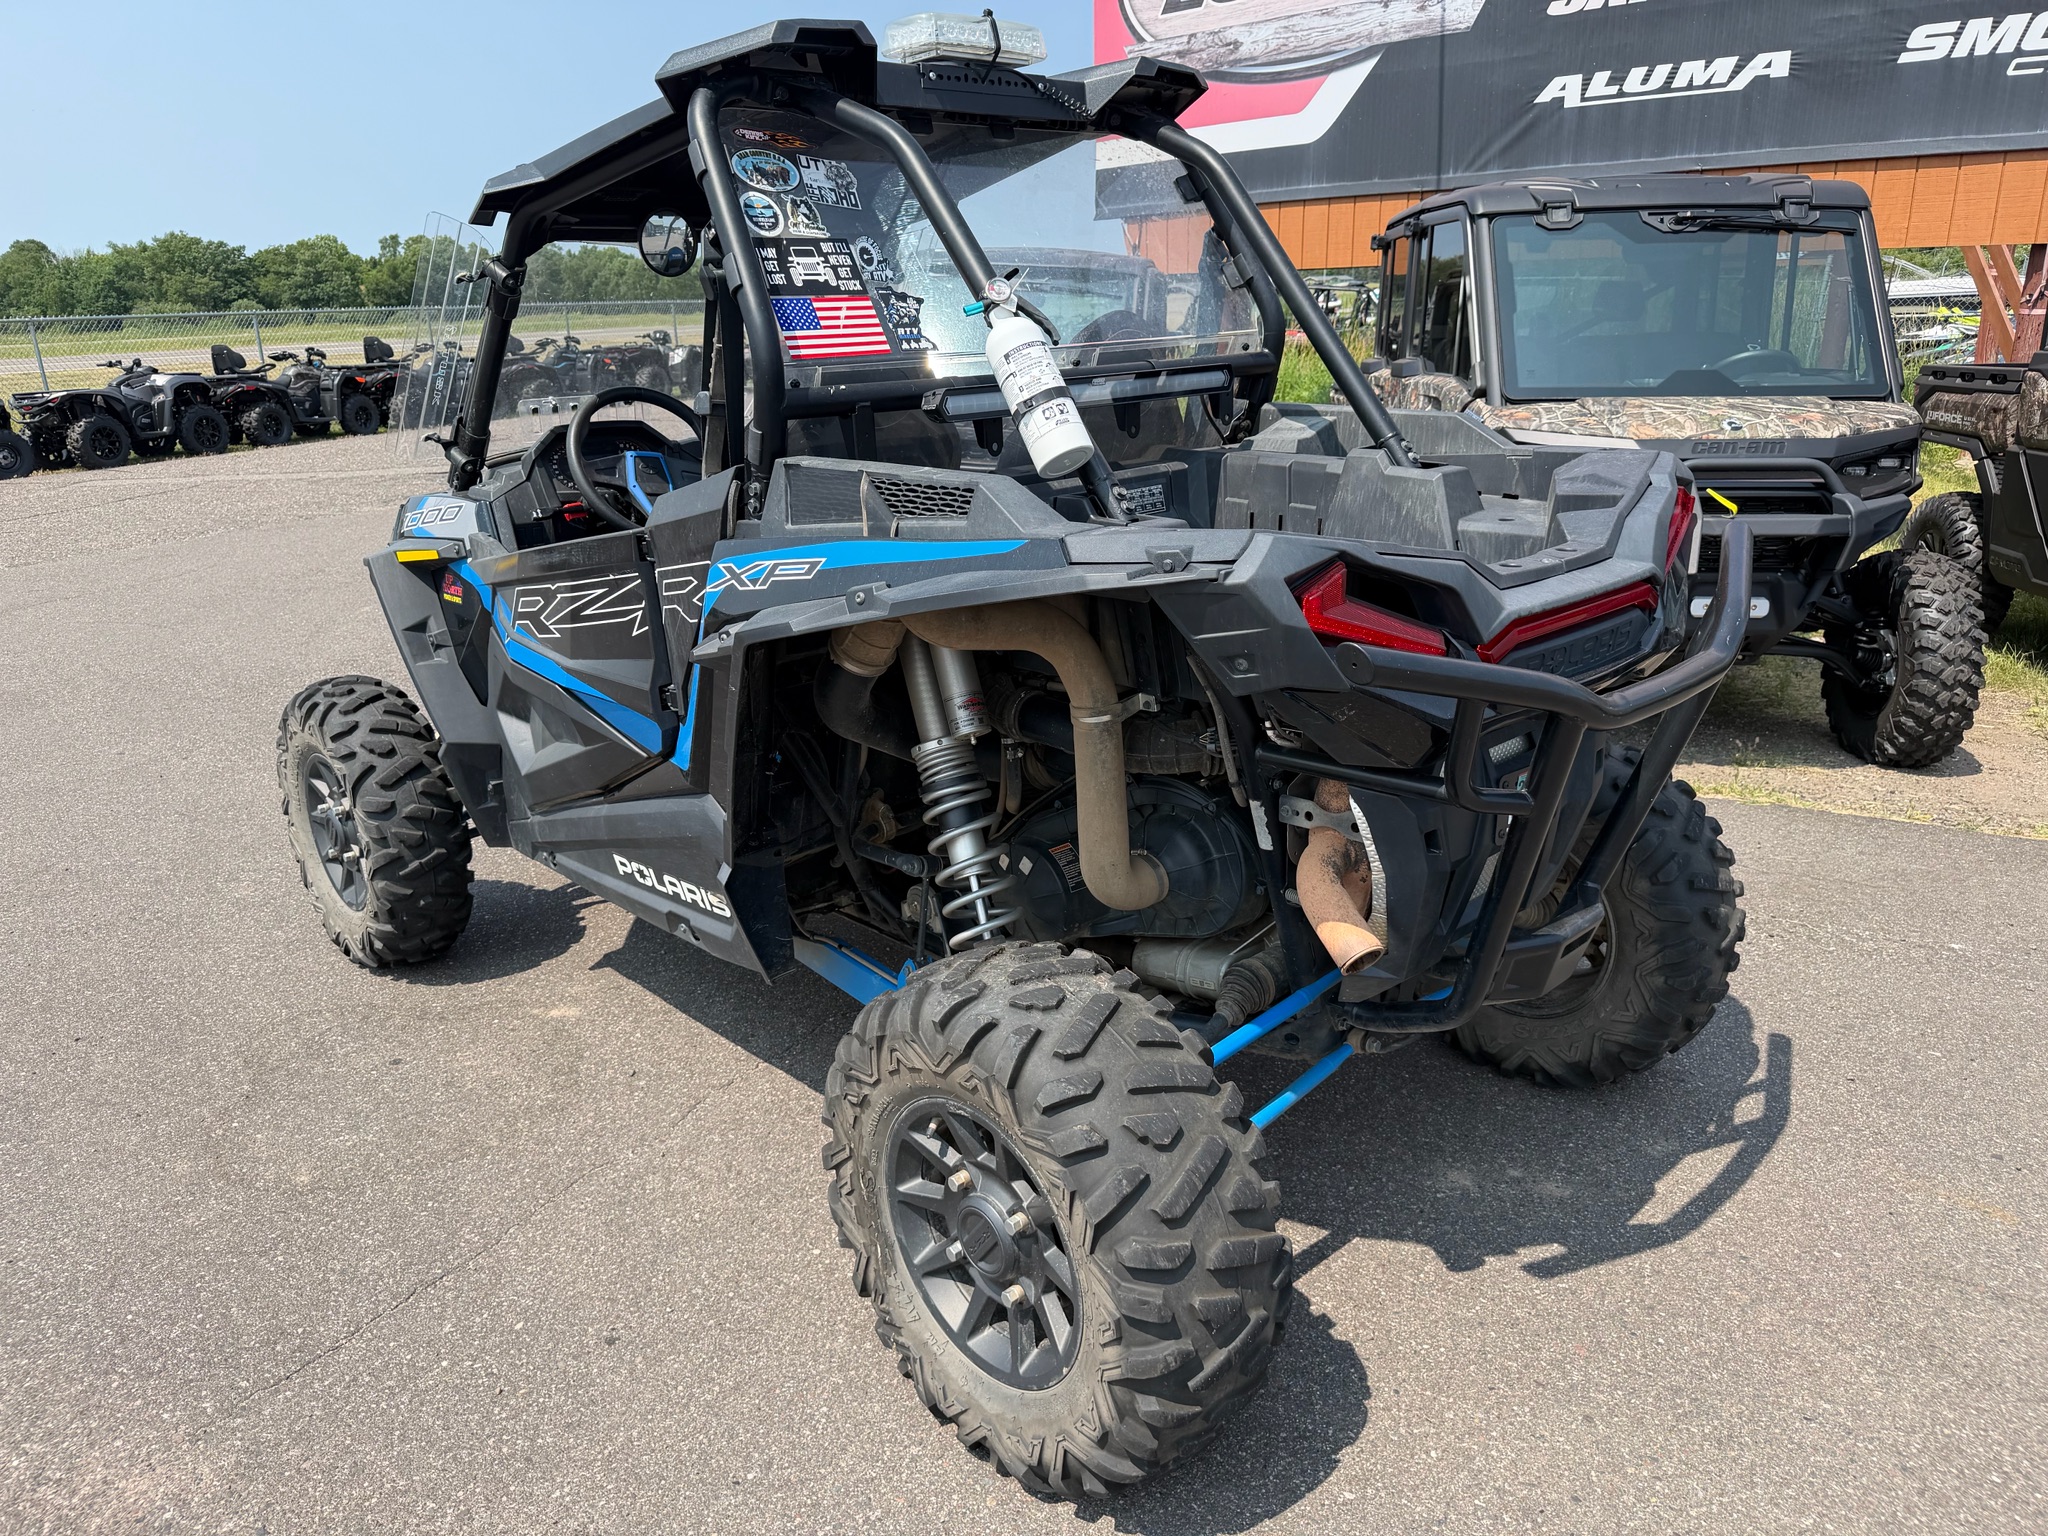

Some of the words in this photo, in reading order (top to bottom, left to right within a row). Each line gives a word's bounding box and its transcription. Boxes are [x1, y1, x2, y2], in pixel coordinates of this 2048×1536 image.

[1533, 50, 1792, 108] ALUMA
[760, 247, 777, 259] MAY
[820, 242, 834, 253] BUT
[834, 241, 850, 253] I'LL
[764, 260, 779, 272] GET
[827, 255, 853, 266] NEVER
[767, 273, 787, 285] LOST
[838, 267, 853, 279] GET
[837, 280, 863, 291] STUCK
[1008, 341, 1043, 357] INSTRUCTIONS
[1691, 440, 1788, 455] can-am
[512, 560, 709, 640] RZR
[707, 557, 827, 592] XP
[612, 852, 732, 918] POLARIS
